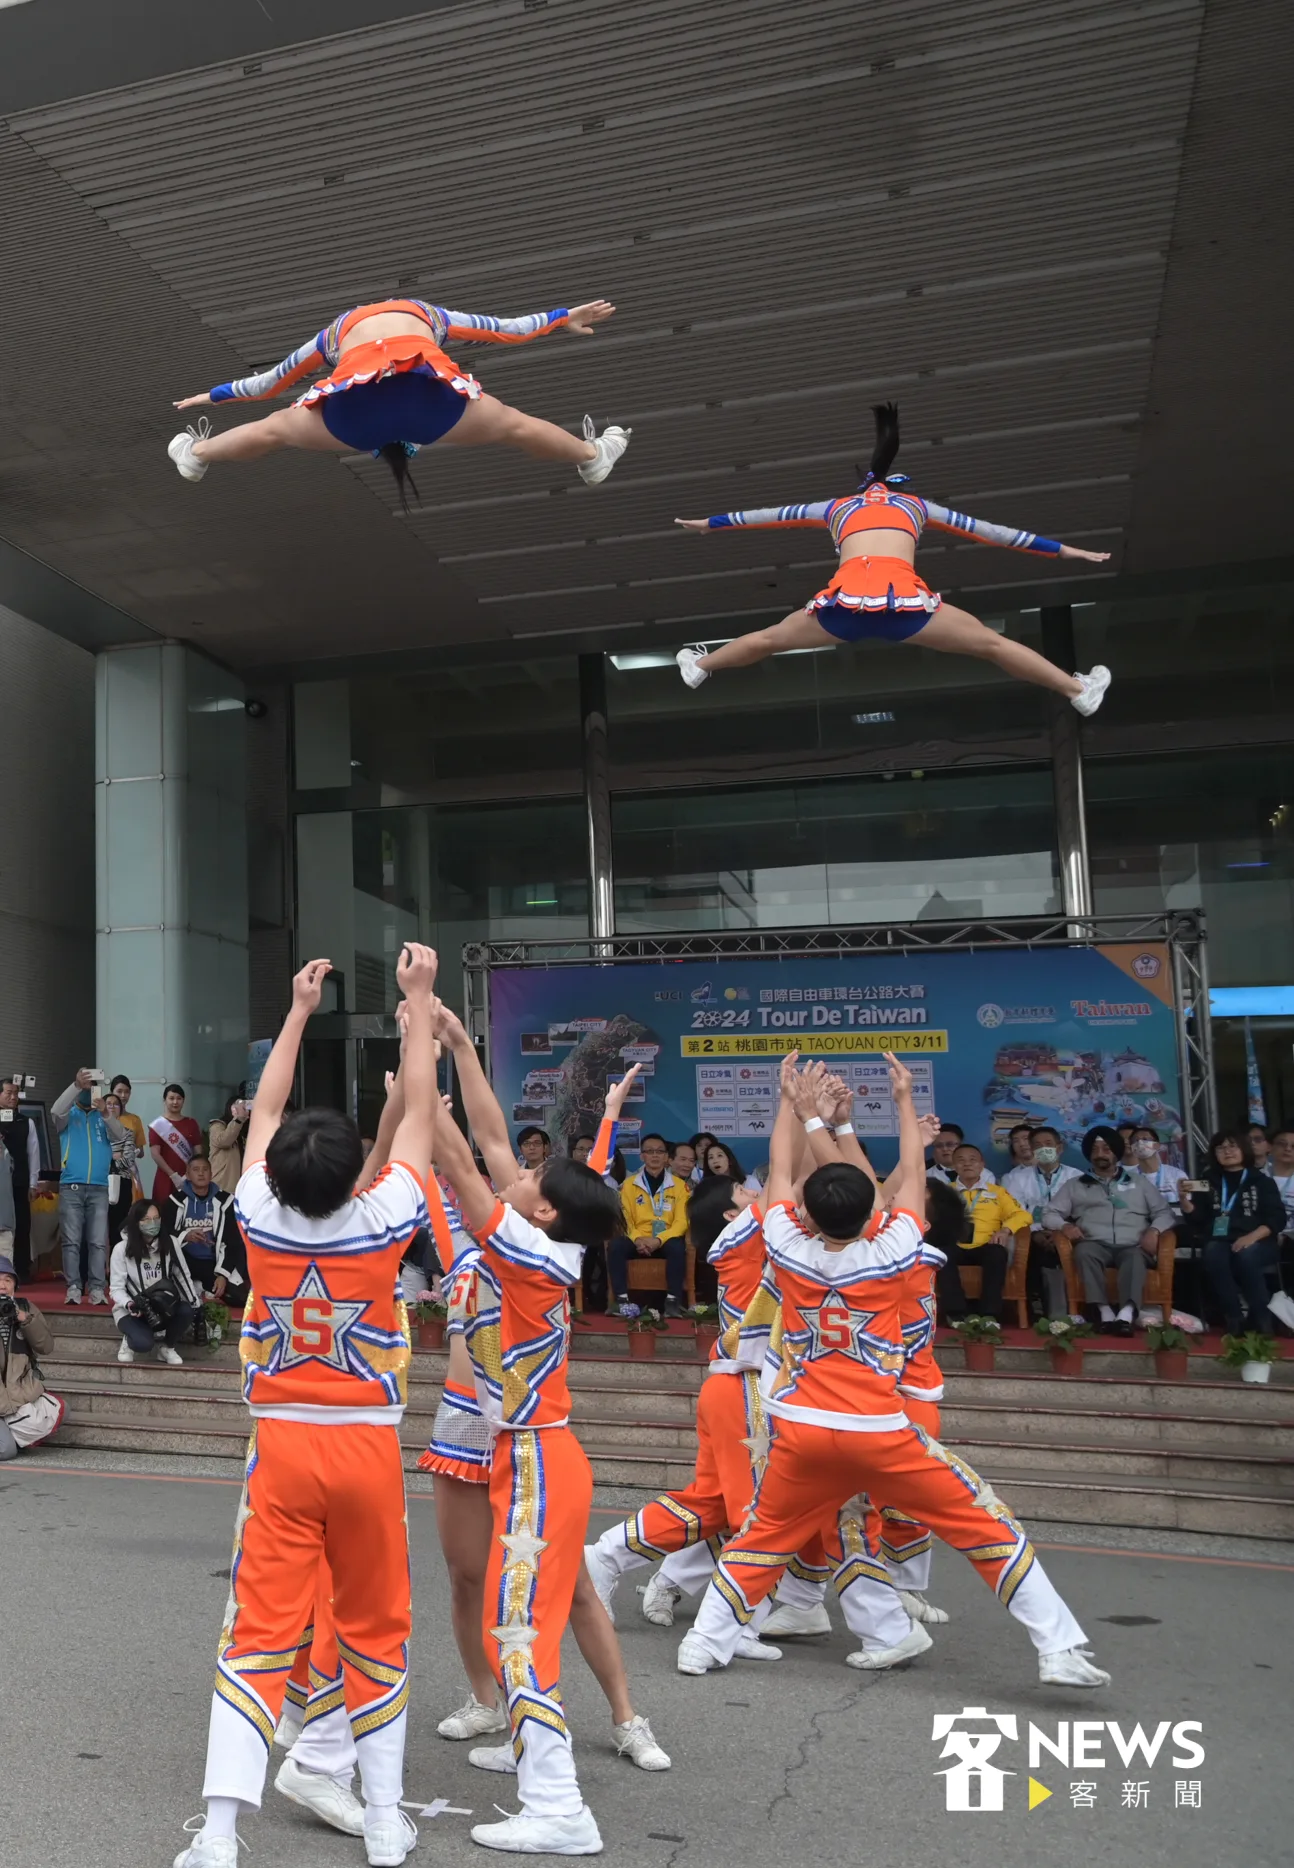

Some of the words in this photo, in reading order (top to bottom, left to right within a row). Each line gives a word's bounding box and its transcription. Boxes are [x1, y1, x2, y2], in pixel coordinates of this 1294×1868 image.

[864, 490, 889, 505] S
[760, 985, 925, 1003] 國際自由車環台公路大賽
[691, 1009, 750, 1028] 2024
[757, 1008, 808, 1027] Tour
[812, 1005, 842, 1026] De
[844, 1004, 927, 1025] Taiwan
[1070, 1000, 1153, 1018] Taiwan
[807, 1036, 874, 1050] TAOYUAN
[878, 1035, 911, 1049] CITY
[913, 1035, 942, 1048] 3/11
[854, 1067, 888, 1076] 日立冷氣
[739, 1087, 771, 1096] 日立冷氣
[184, 1217, 213, 1228] Roots
[292, 1298, 334, 1355] S
[818, 1306, 853, 1350] S
